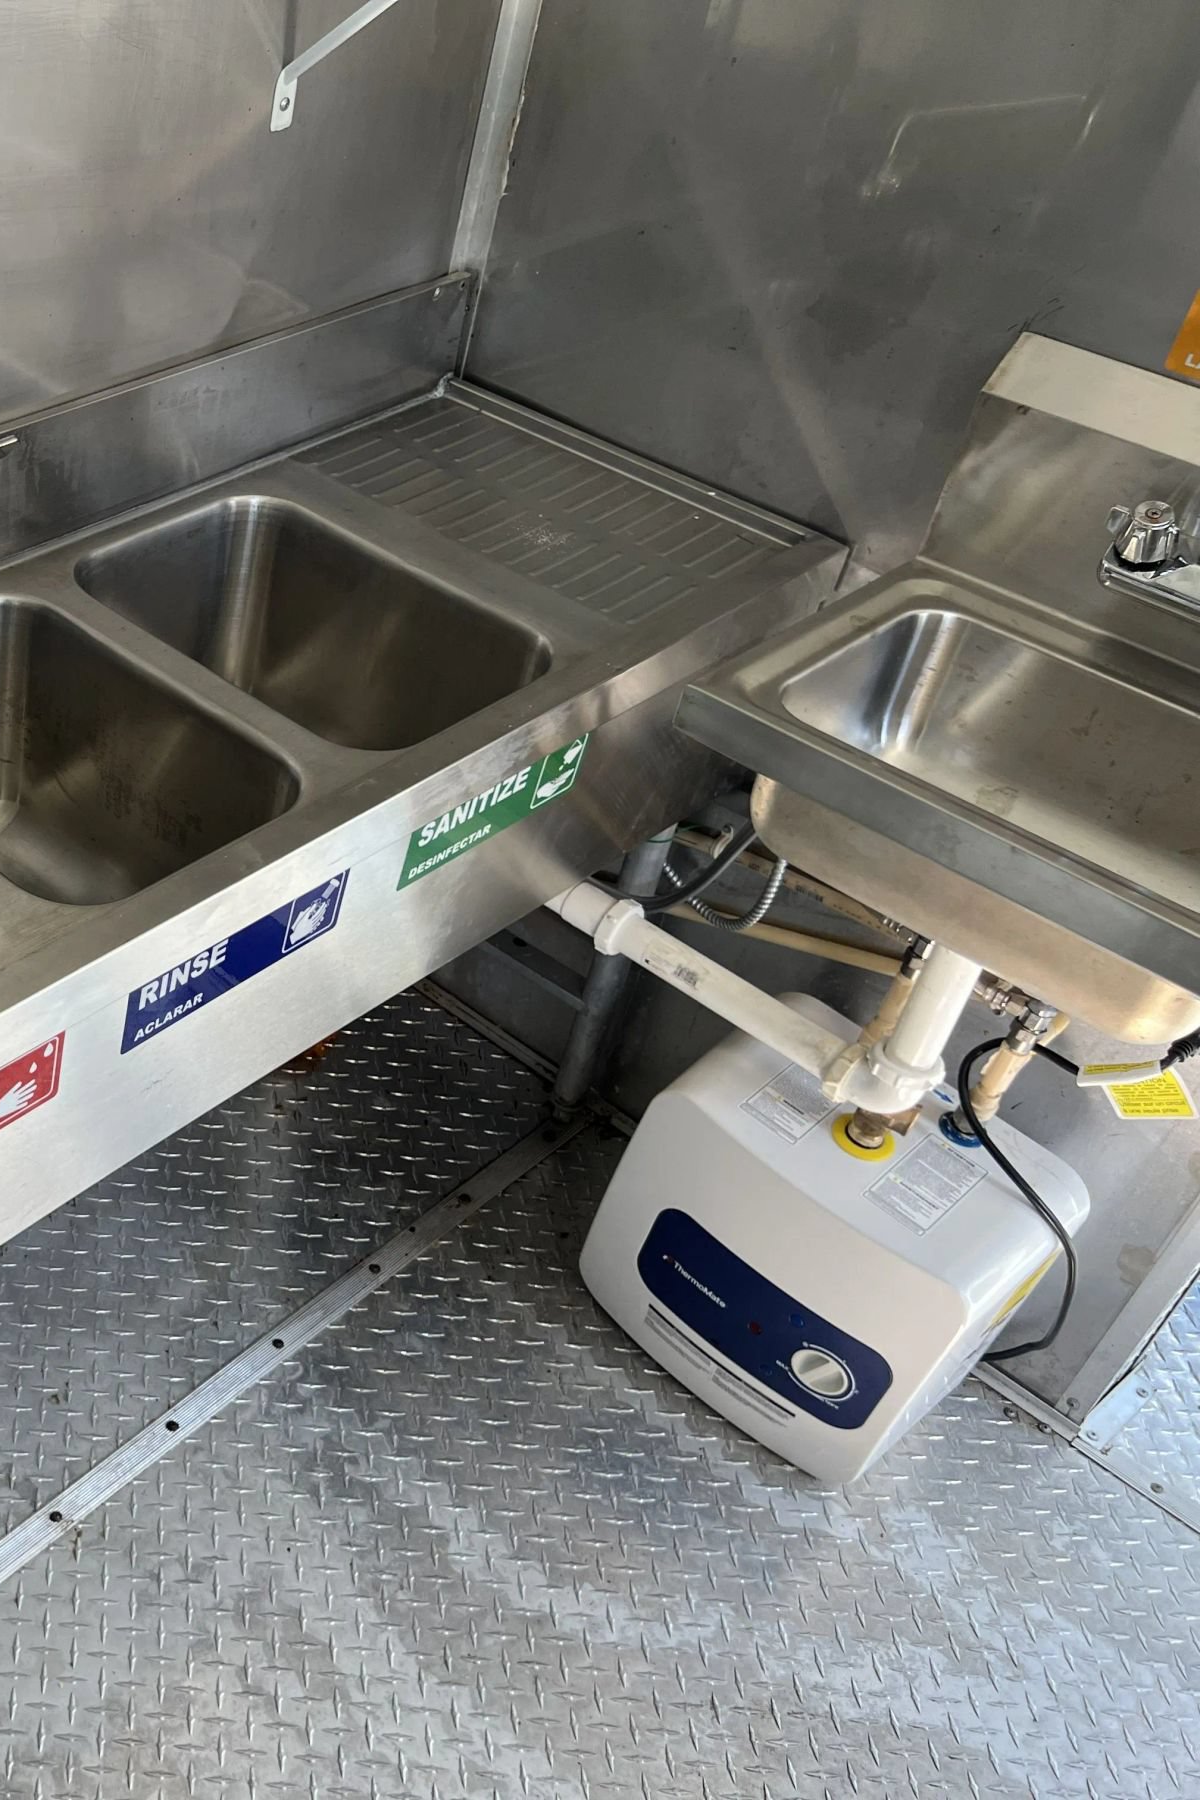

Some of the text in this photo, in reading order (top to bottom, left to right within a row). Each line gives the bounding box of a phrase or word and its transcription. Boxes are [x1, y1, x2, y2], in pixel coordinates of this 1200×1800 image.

[418, 766, 531, 847] SANITIZE
[408, 824, 492, 879] DESINFECTAR
[138, 939, 229, 1011] RINSE
[134, 992, 204, 1042] ACLARAR
[674, 1262, 726, 1308] ThermoMate
